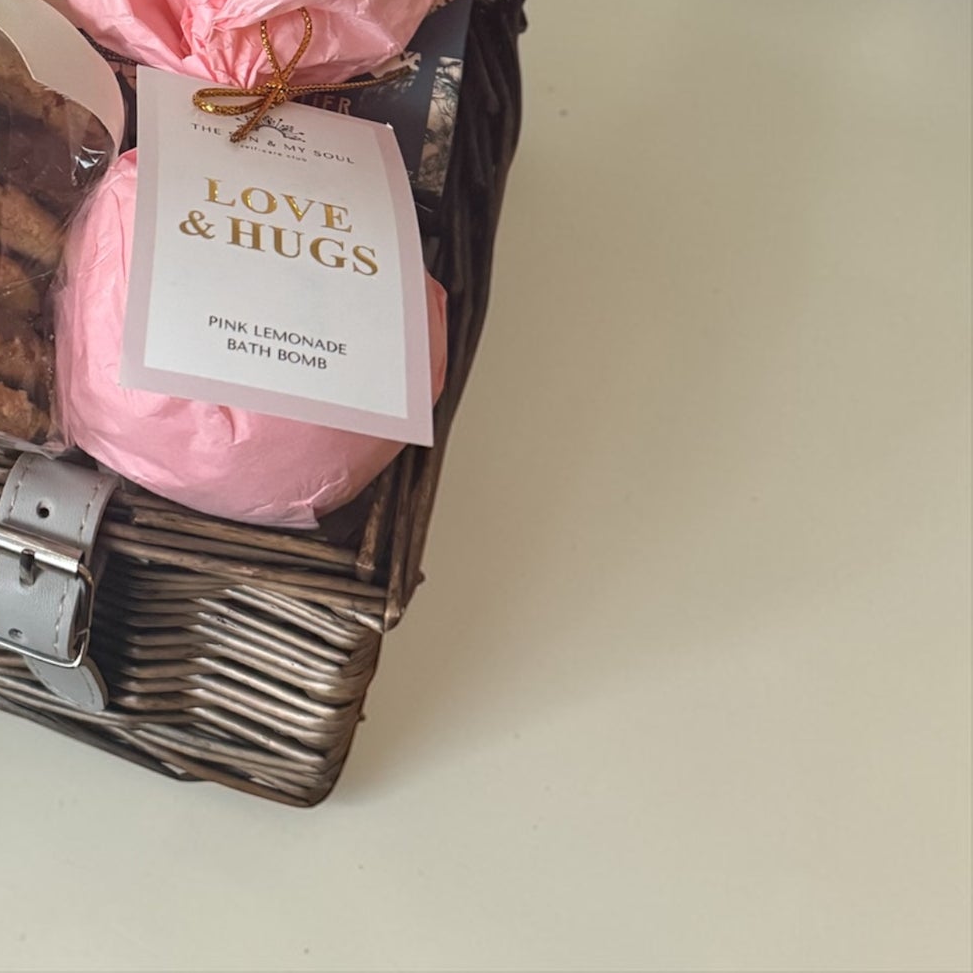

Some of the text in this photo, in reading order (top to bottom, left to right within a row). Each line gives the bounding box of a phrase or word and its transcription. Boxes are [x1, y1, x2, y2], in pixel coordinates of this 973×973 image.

[191, 123, 222, 136] THE
[283, 143, 307, 154] MY
[313, 150, 355, 164] SOUL
[203, 177, 353, 233] LOVE
[179, 210, 379, 276] & HUGS
[208, 315, 347, 356] PINK LEMONADE
[227, 338, 327, 370] BATH BOMB
